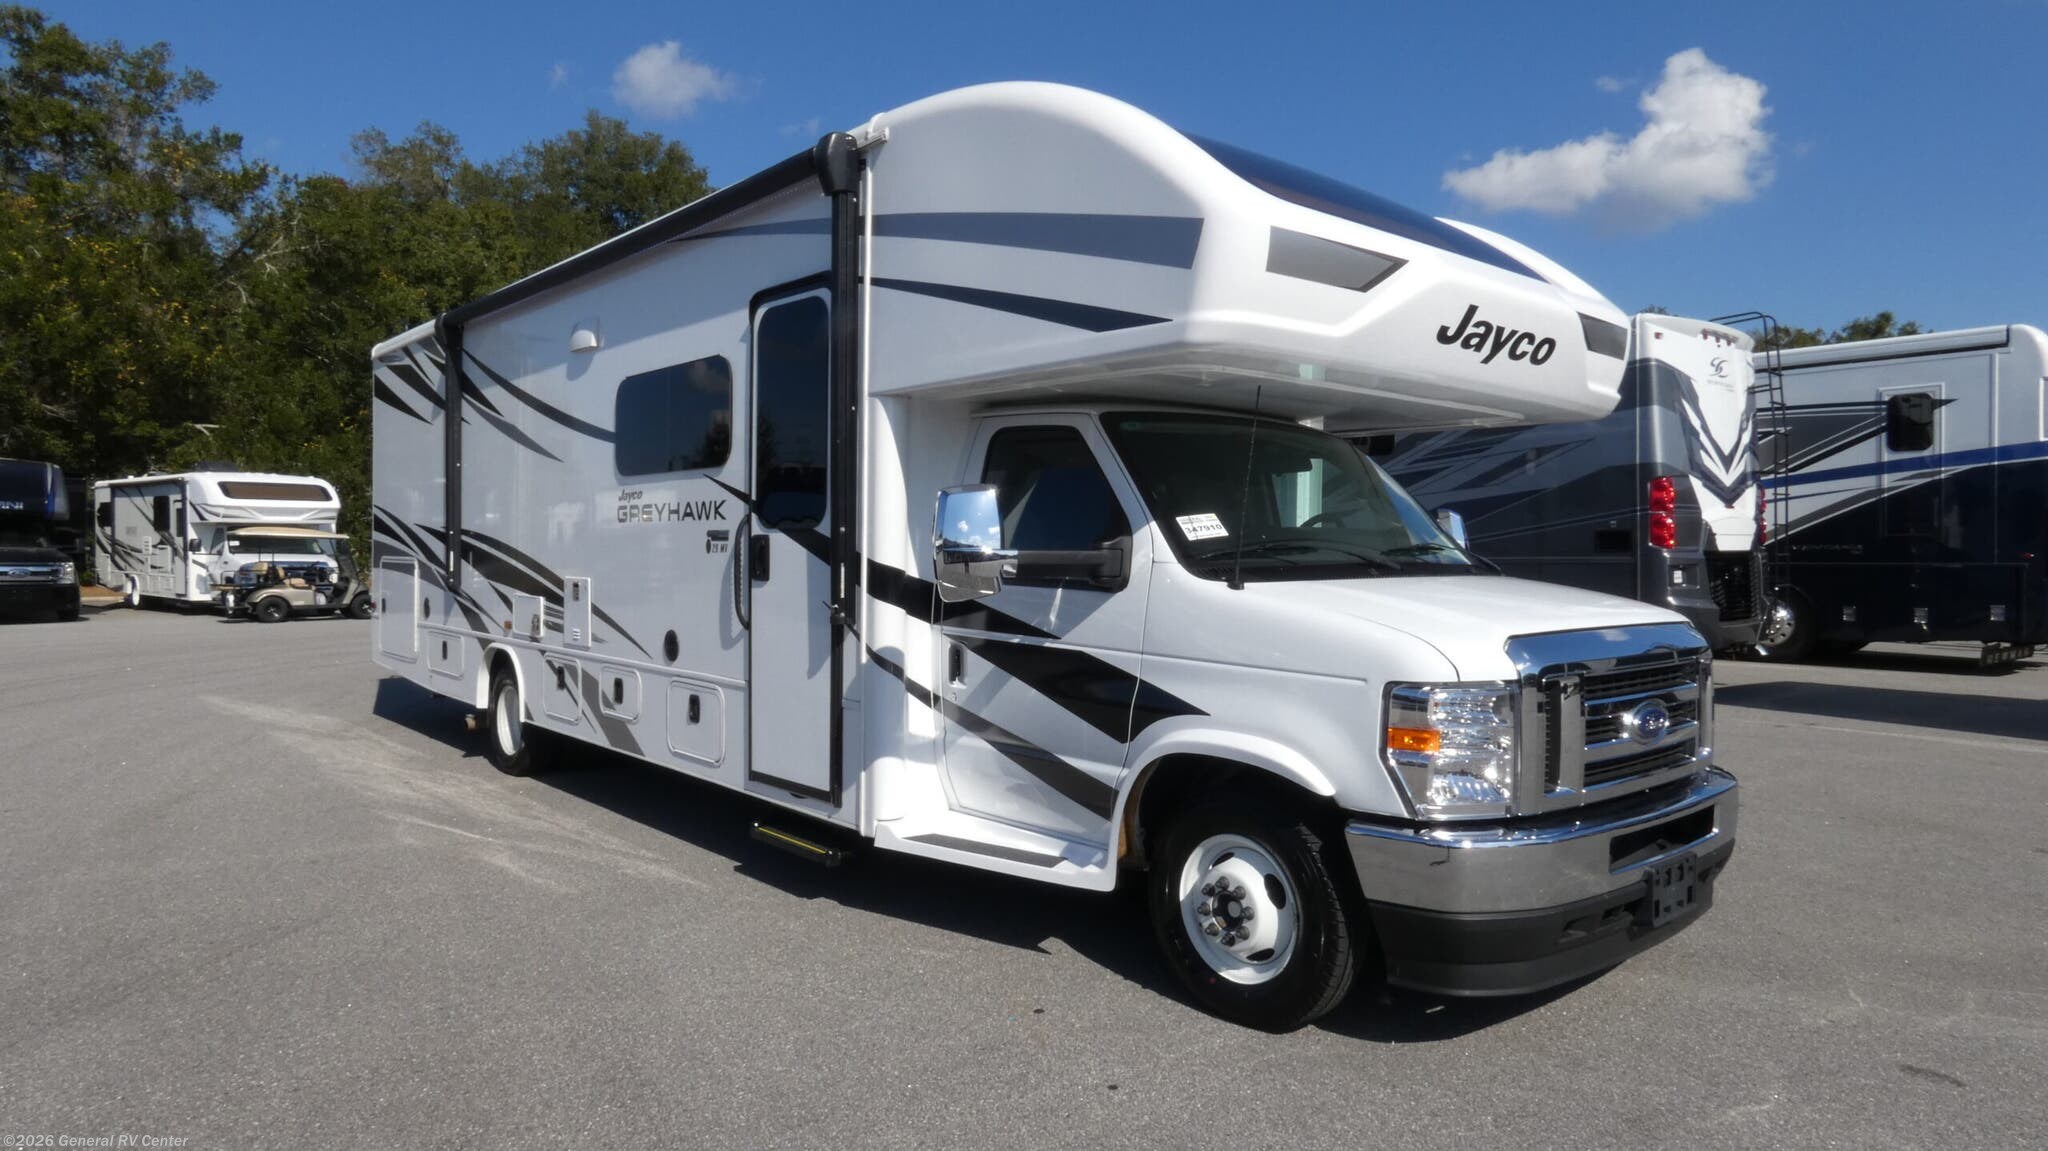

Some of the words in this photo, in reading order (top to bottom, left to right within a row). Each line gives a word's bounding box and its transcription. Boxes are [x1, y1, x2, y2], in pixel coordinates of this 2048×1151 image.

[1436, 304, 1556, 366] Jayco
[618, 489, 643, 503] Jayco
[617, 499, 727, 523] GREYHAWK
